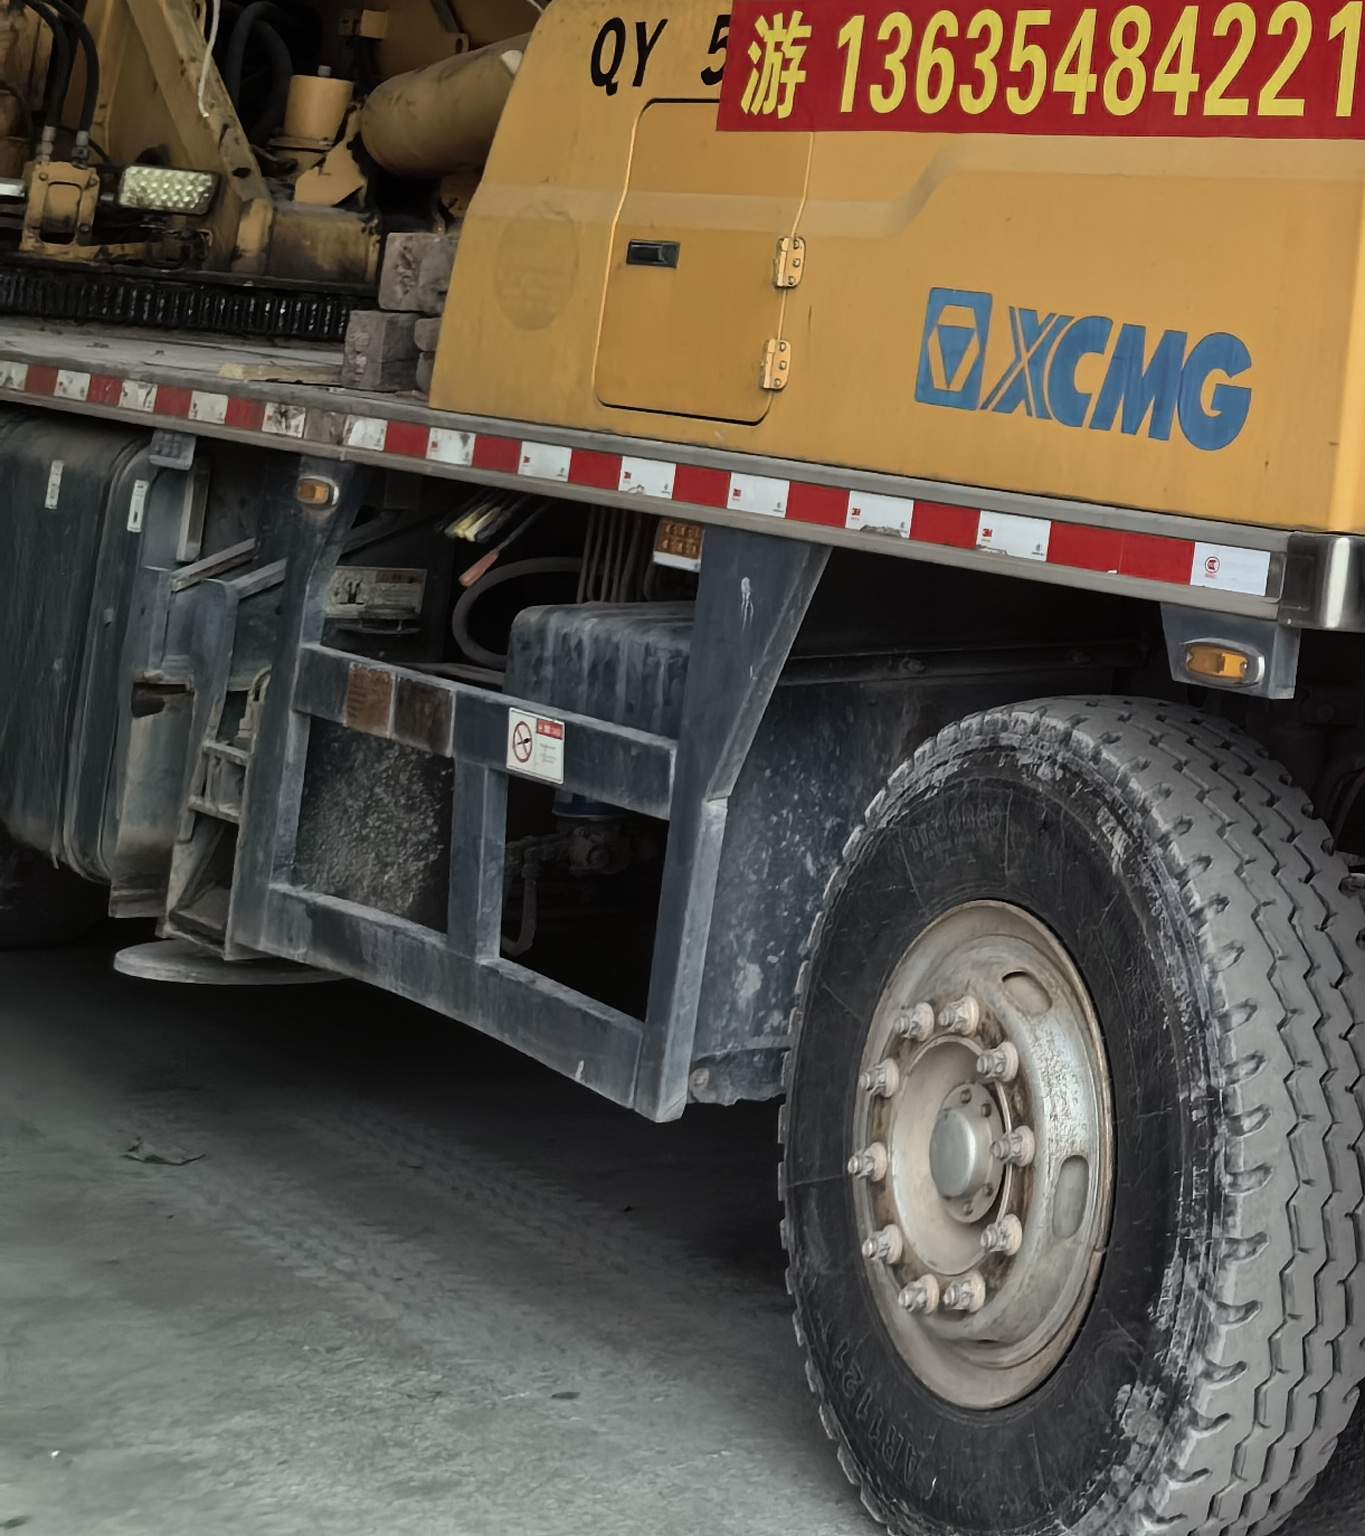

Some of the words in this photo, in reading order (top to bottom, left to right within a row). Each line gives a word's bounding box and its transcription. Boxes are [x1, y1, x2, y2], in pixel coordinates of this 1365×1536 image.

[589, 15, 668, 96] QY
[740, 9, 813, 120] 游
[836, 0, 1364, 118] 13635484221
[981, 305, 1253, 452] XCMG
